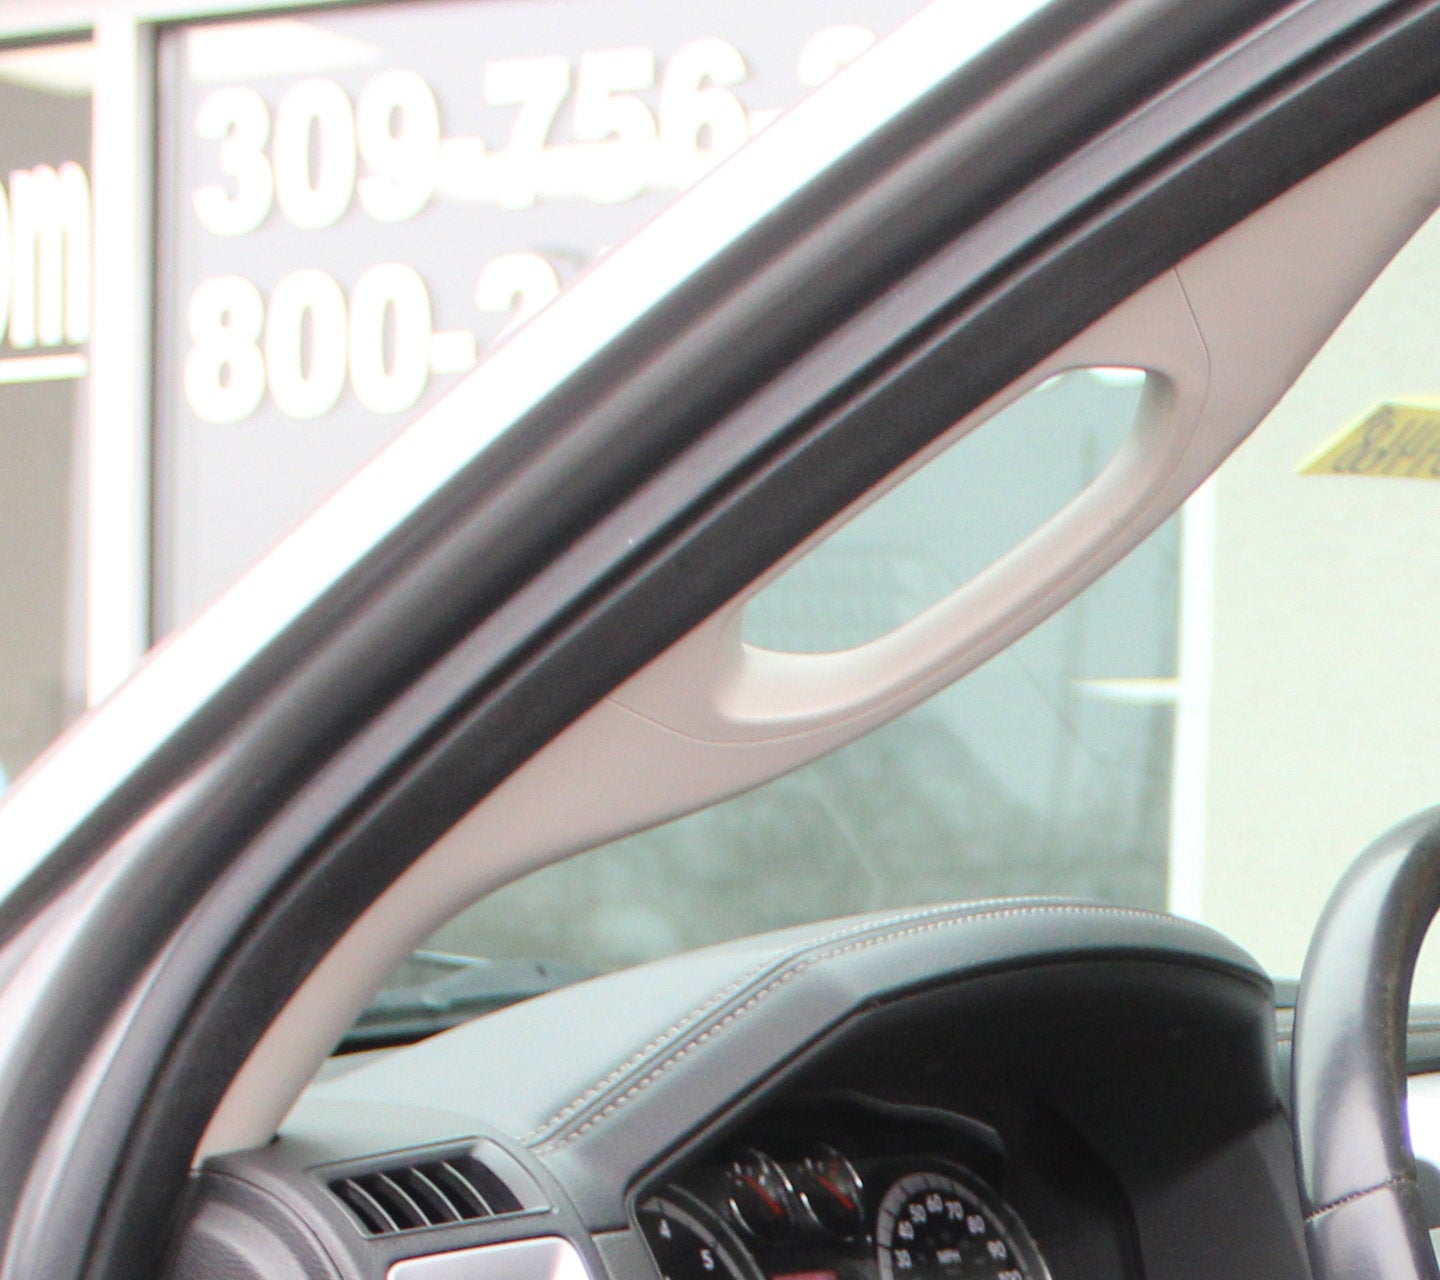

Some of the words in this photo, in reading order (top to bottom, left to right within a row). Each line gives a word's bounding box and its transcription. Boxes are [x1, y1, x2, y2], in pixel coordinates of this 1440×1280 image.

[185, 250, 612, 424] 800-2
[944, 1200, 964, 1220] 70
[659, 1218, 672, 1239] 4
[699, 1248, 715, 1271] 5
[986, 1240, 1008, 1260] 90
